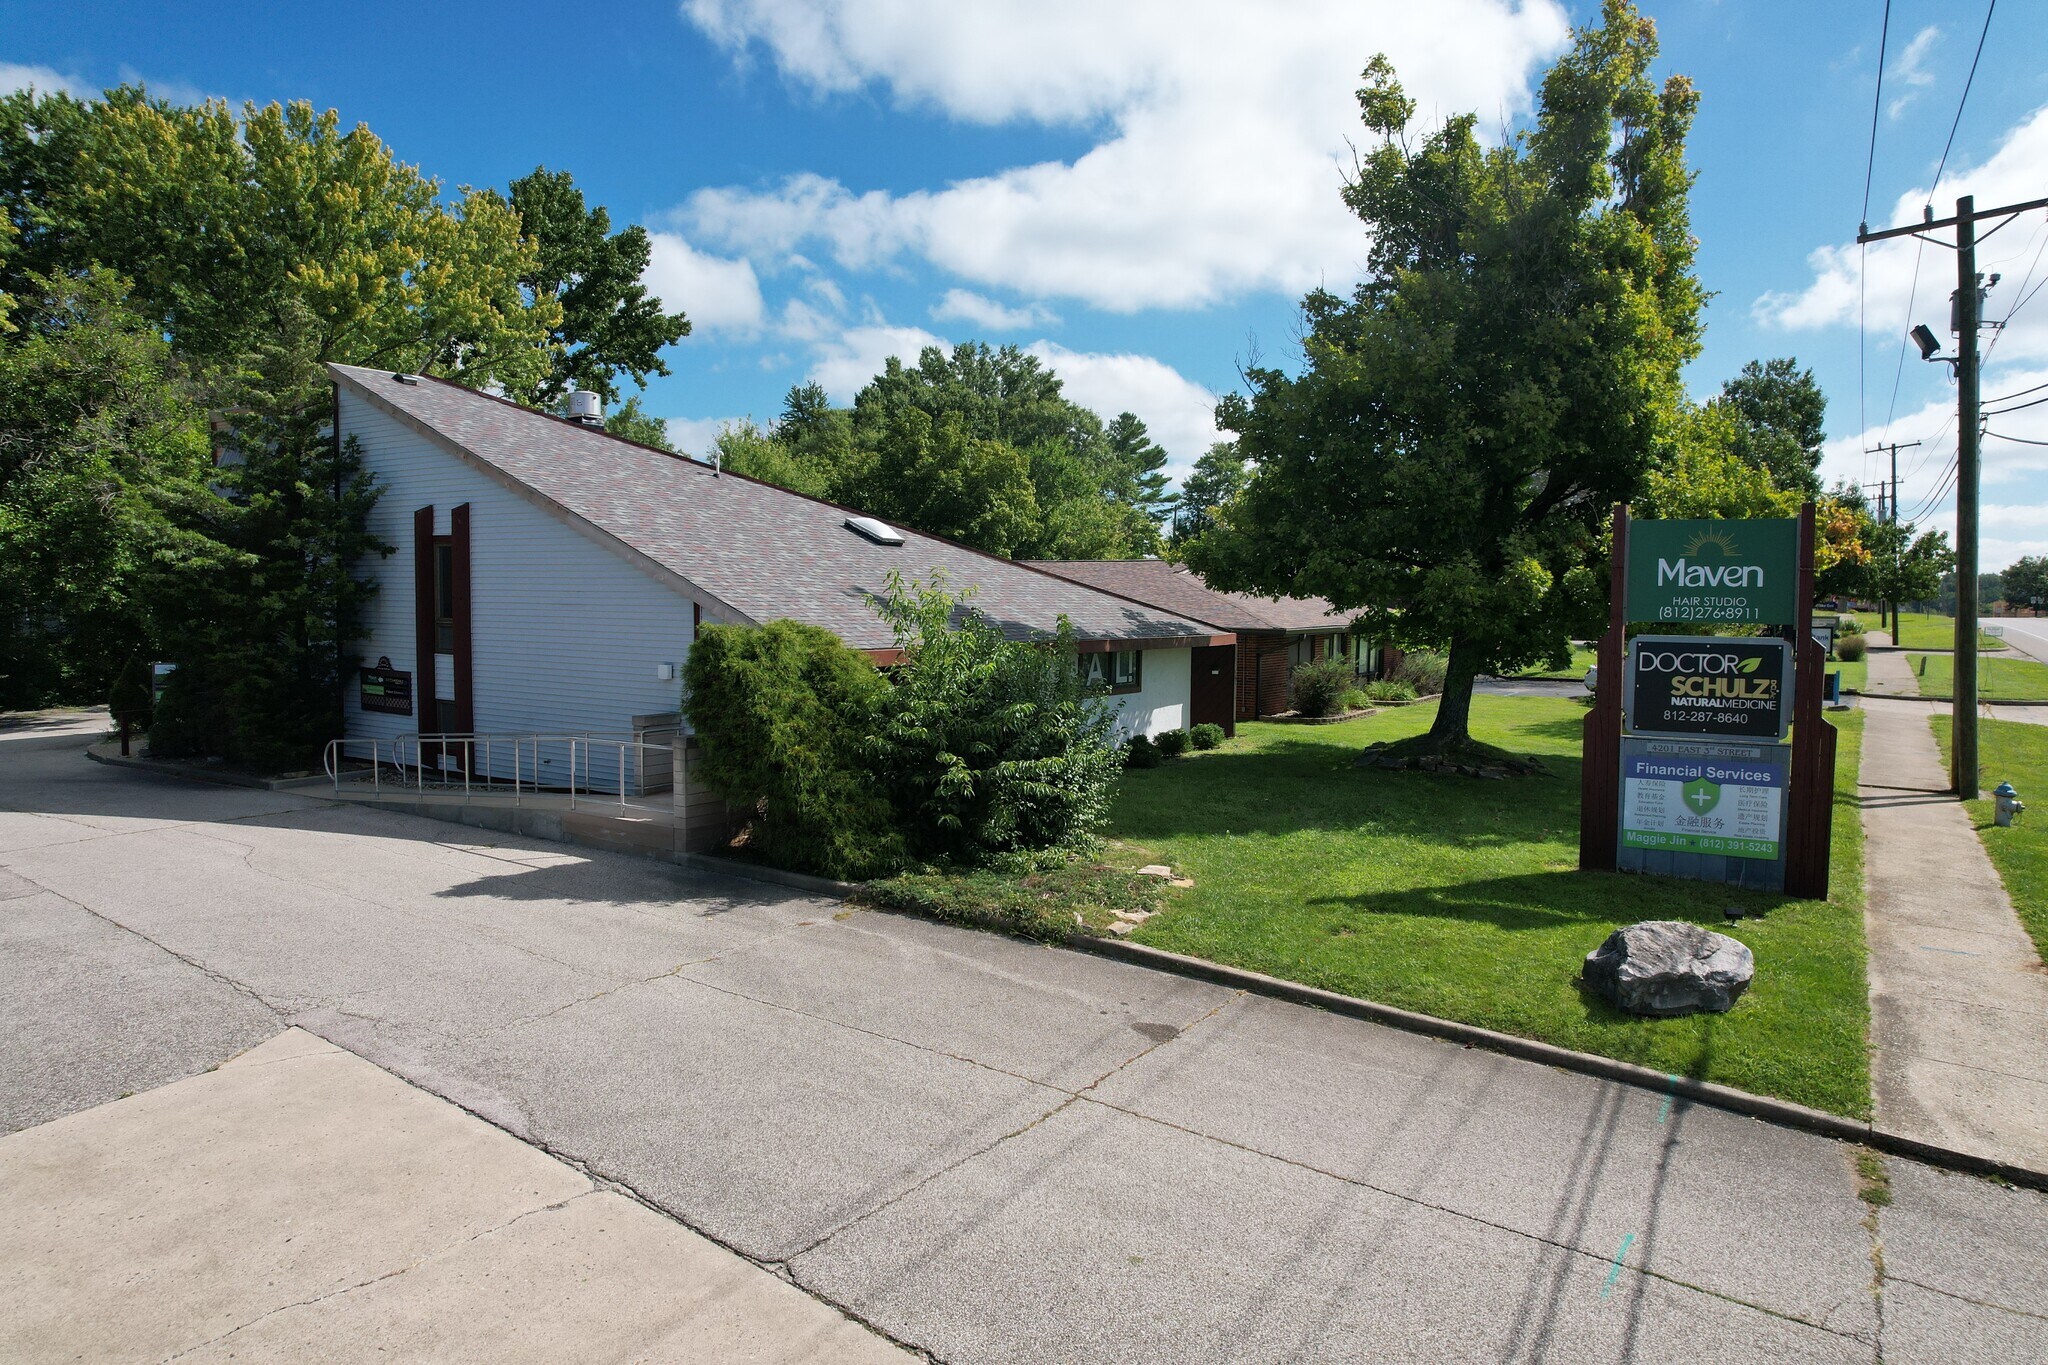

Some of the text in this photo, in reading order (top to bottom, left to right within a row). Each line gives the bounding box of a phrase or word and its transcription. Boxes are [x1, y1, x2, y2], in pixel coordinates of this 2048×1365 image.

[1658, 558, 1764, 588] Maven
[1672, 596, 1746, 606] HAIR STUDIO
[1640, 652, 1738, 674] DOCTOR
[1670, 676, 1770, 699] SCHULZ
[1664, 710, 1748, 724] 812-287-8640
[1678, 746, 1700, 754] EAST
[1718, 748, 1752, 756] STREET
[1636, 762, 1771, 782] Financial Services
[1637, 792, 1665, 800] 教育基金
[1737, 800, 1768, 808] 医疗保险
[1674, 814, 1725, 830] 金融服务
[1627, 832, 1773, 853] Maggie Jin (812) 391-5243
